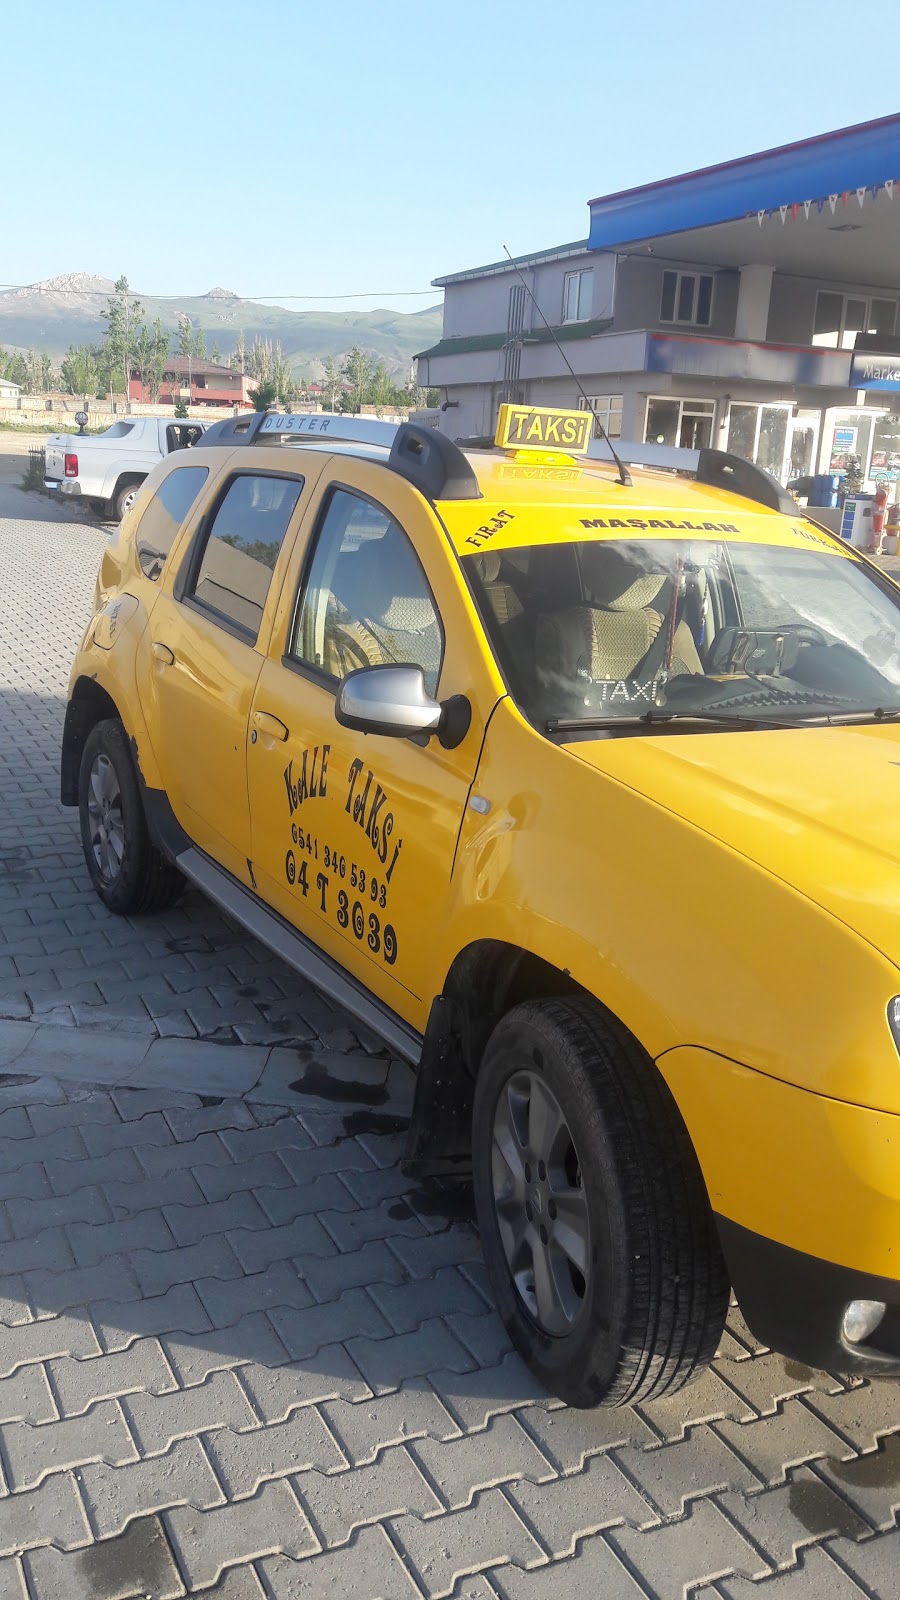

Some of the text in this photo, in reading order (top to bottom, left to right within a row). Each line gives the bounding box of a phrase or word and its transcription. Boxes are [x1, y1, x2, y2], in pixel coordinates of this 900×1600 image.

[265, 416, 331, 432] DUSTER
[465, 509, 516, 547] FIRAT
[579, 516, 741, 535] MAŞALLAH
[596, 681, 657, 701] TAXI
[284, 745, 331, 816] KALE
[292, 822, 318, 860] 0541
[350, 863, 366, 894] 53
[370, 877, 387, 909] 93
[285, 849, 398, 966] 04 T 3039
